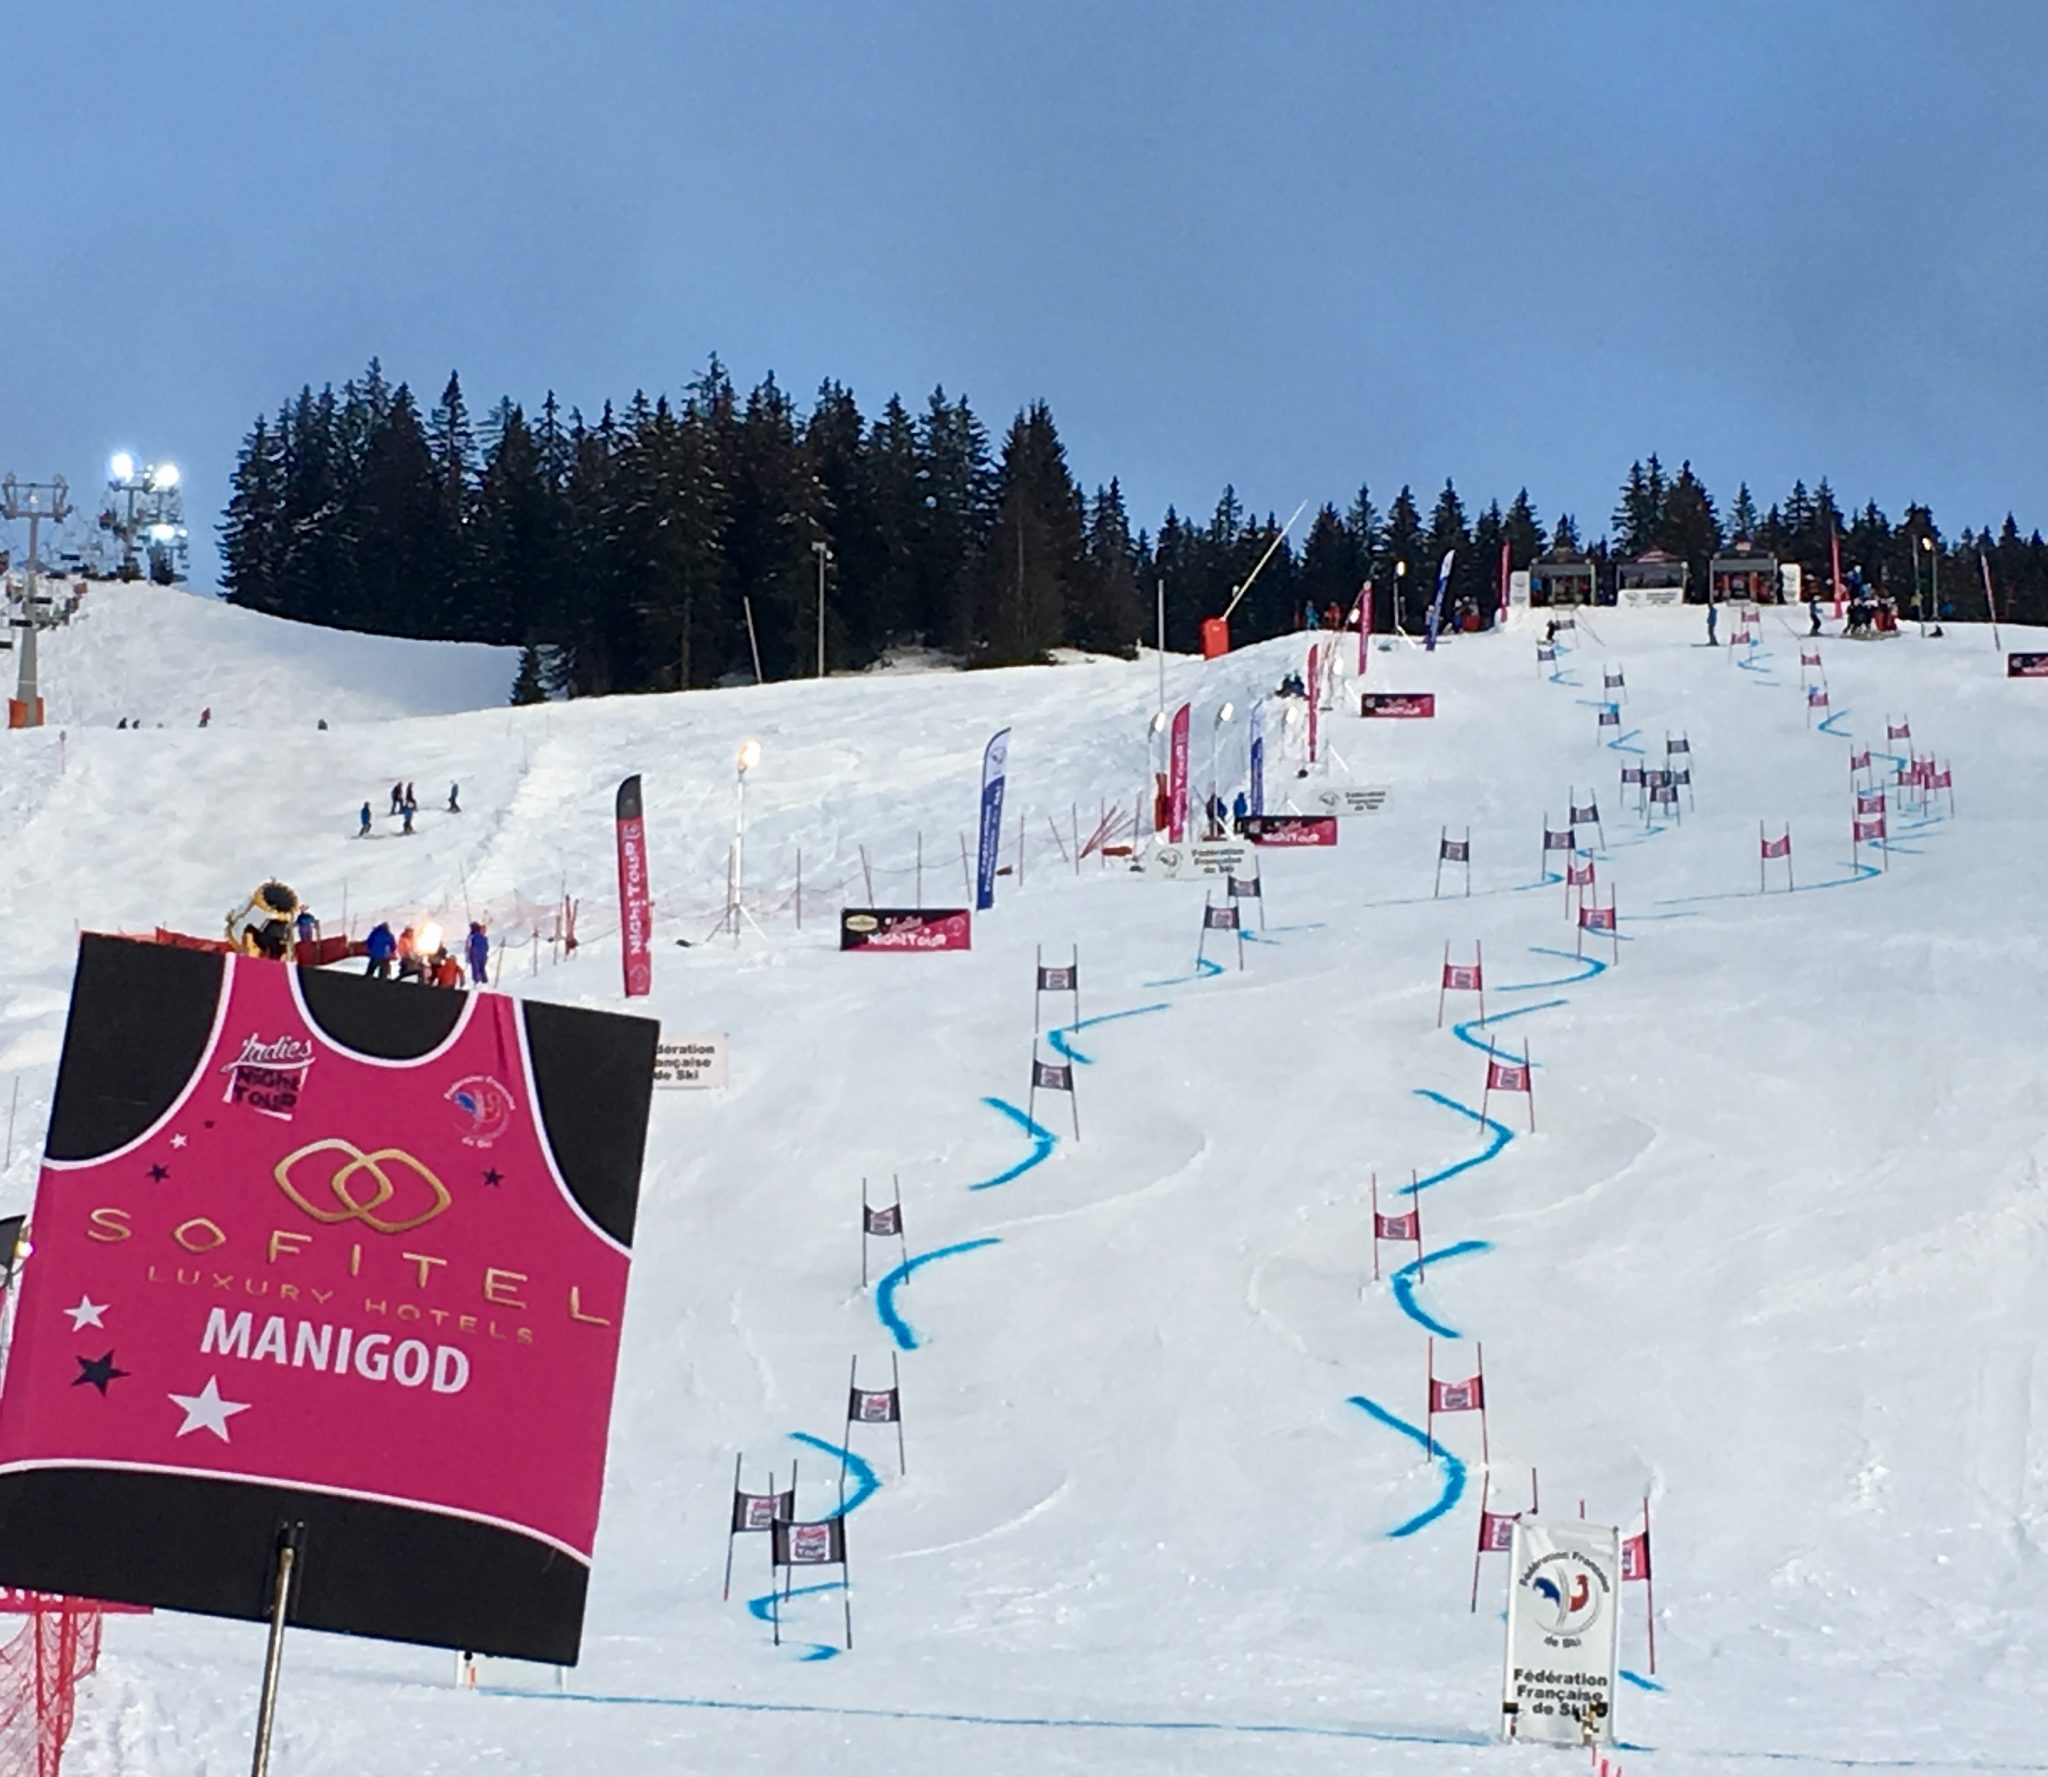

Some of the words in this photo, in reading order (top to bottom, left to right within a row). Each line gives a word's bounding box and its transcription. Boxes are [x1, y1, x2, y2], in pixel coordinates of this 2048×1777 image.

[87, 1208, 611, 1327] SOFITEL
[148, 1265, 334, 1304] LUXURY
[364, 1297, 534, 1345] HOTELS
[200, 1306, 470, 1395] MANIGOD
[1513, 1668, 1608, 1687] Fédération
[1516, 1684, 1604, 1703] Française
[1531, 1702, 1554, 1716] de
